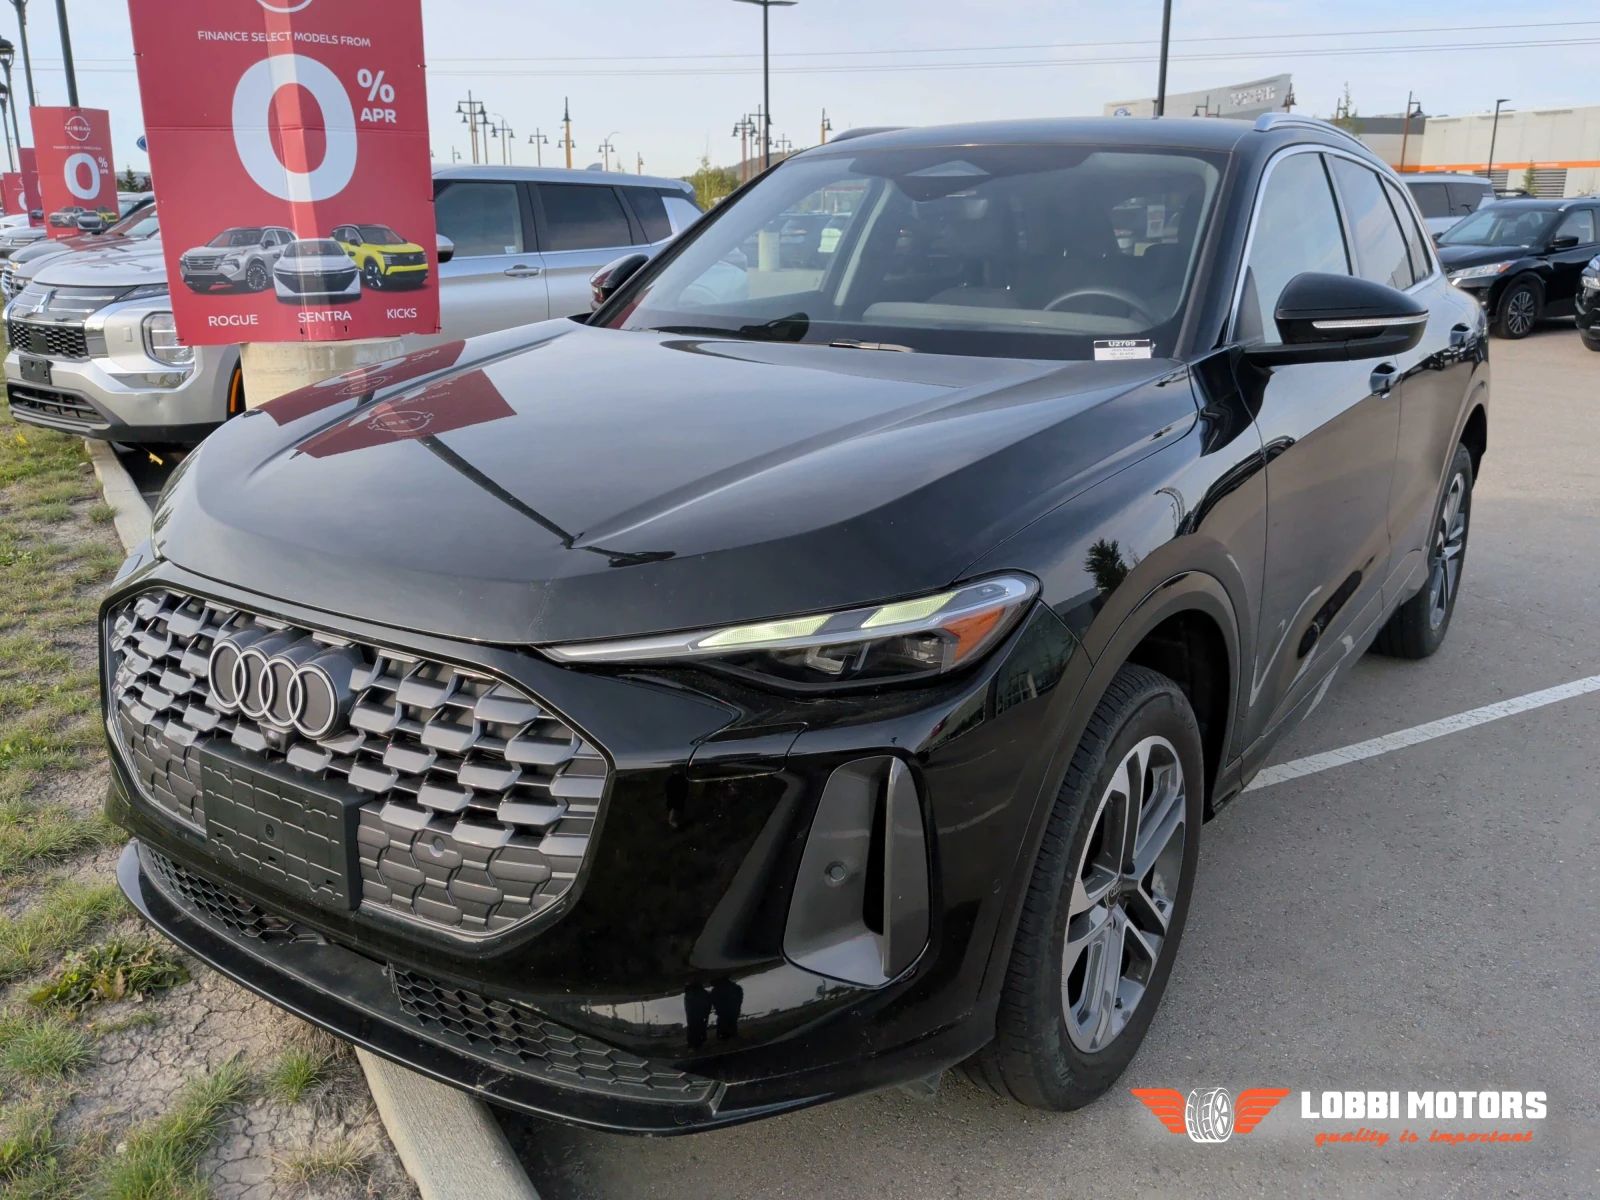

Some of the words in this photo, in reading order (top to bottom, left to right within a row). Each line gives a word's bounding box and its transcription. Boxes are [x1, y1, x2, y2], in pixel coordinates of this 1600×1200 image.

[197, 30, 249, 42] FINANCE
[251, 31, 292, 42] SELECT
[294, 32, 339, 45] MODELS
[340, 36, 371, 47] FROM
[360, 107, 397, 124] APR
[232, 53, 358, 202] 0
[356, 68, 395, 103] %
[64, 152, 100, 200] 0
[207, 314, 259, 327] ROGUE
[297, 310, 353, 323] SENTRA
[386, 307, 418, 319] KICKS
